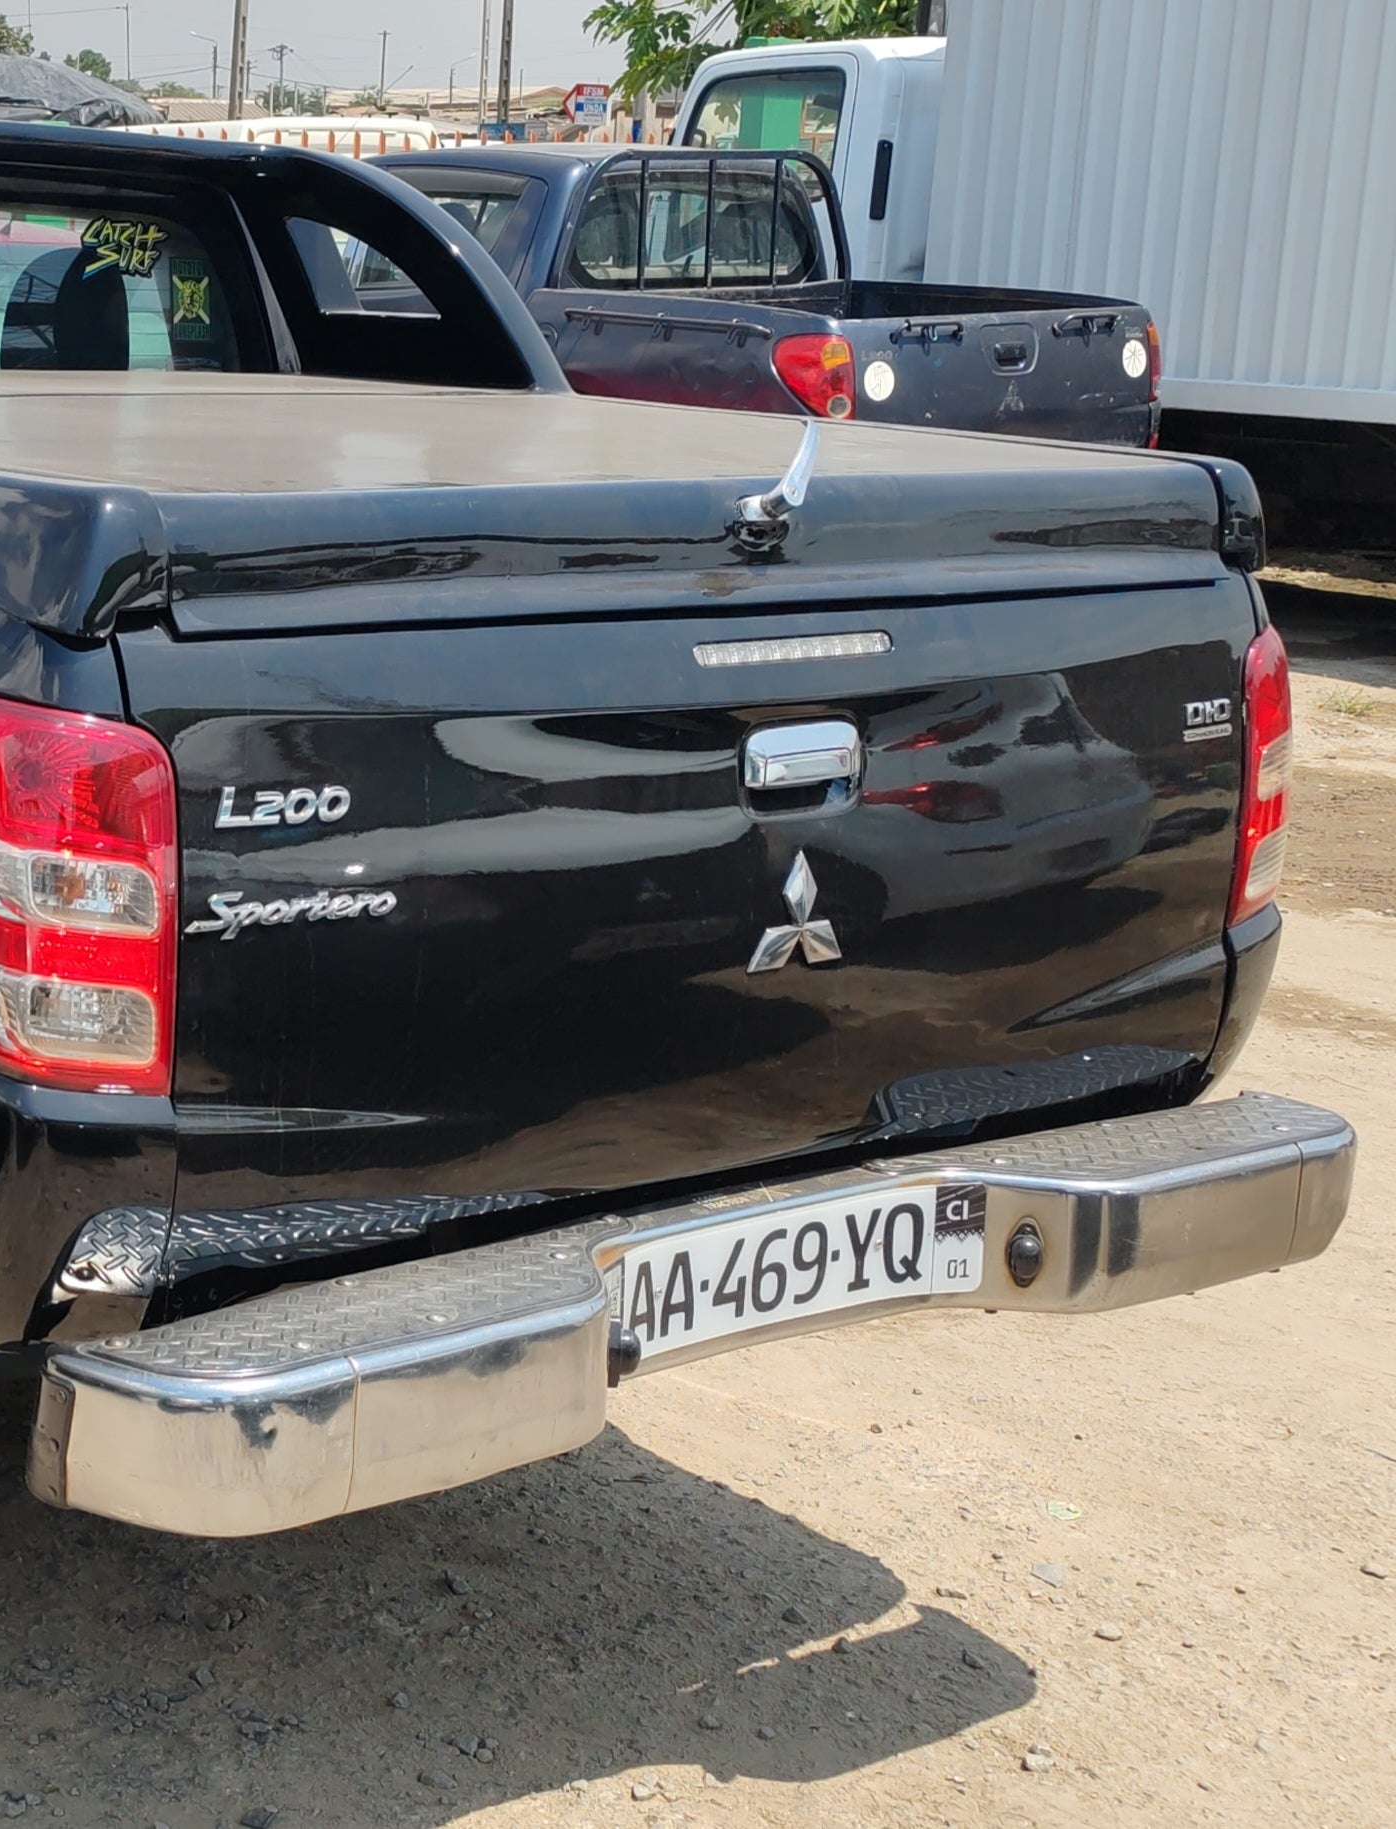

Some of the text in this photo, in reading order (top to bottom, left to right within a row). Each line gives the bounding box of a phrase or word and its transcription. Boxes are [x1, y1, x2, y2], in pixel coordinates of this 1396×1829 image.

[83, 217, 169, 248] CATCH
[83, 243, 161, 279] SURF
[214, 785, 351, 829] L200
[184, 889, 397, 941] Sportero
[946, 1199, 969, 1221] CI
[946, 1257, 970, 1280] 01
